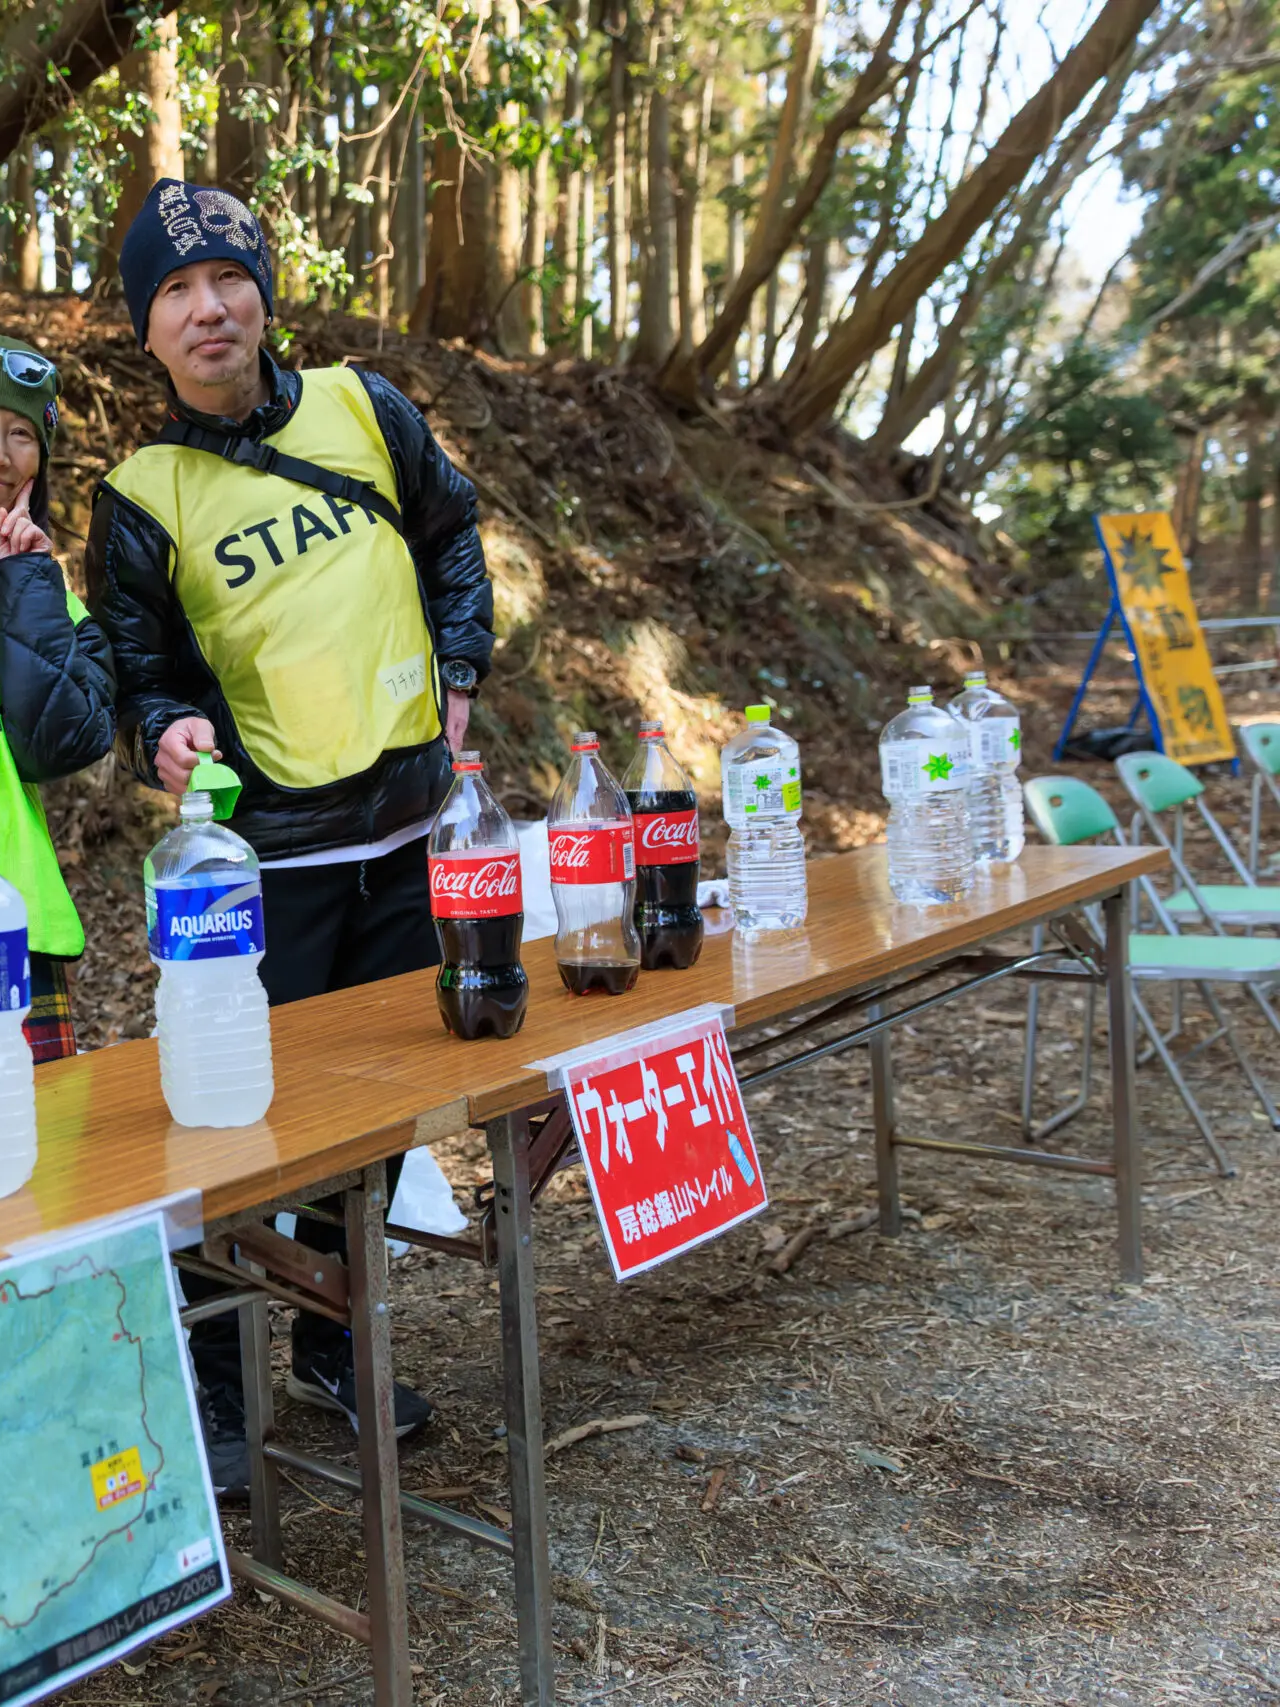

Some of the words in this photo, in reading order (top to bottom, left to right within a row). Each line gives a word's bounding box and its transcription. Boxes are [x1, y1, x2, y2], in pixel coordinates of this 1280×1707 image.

[431, 858, 519, 900] Coca-Cola
[169, 909, 253, 938] AQUARIUS
[575, 1031, 735, 1174] ウォーターエイド
[615, 1164, 733, 1245] 房総鋸山トレイル
